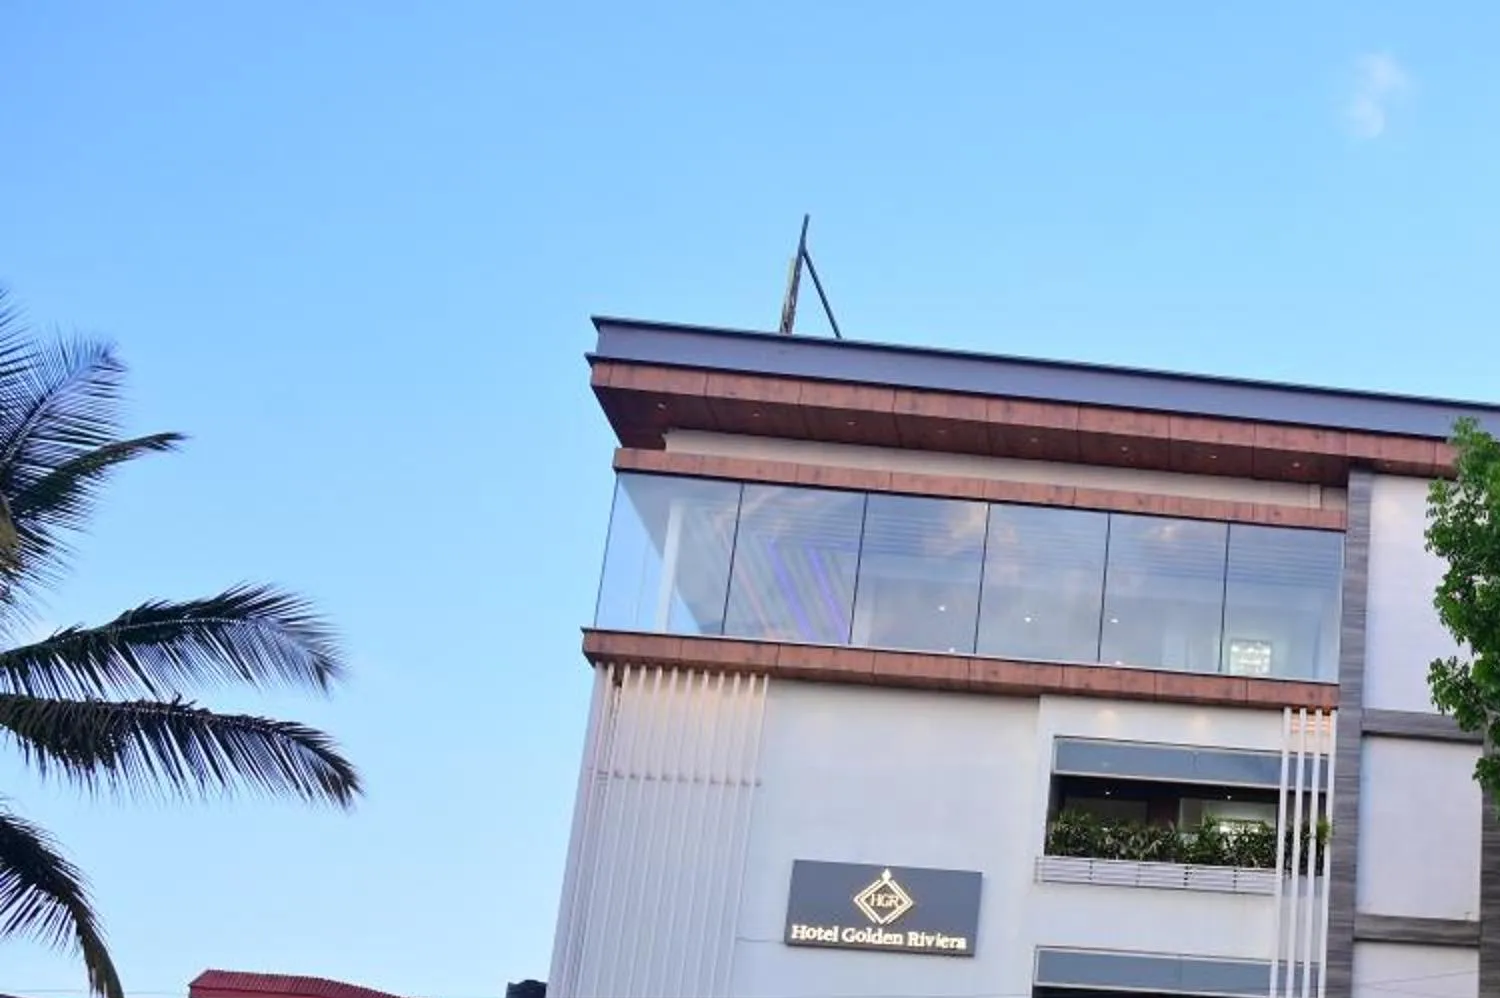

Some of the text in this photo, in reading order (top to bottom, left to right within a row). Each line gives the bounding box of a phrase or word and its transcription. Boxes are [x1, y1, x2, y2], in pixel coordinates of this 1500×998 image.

[869, 892, 900, 909] HGR
[791, 924, 967, 950] Hotel Golden Riviera
